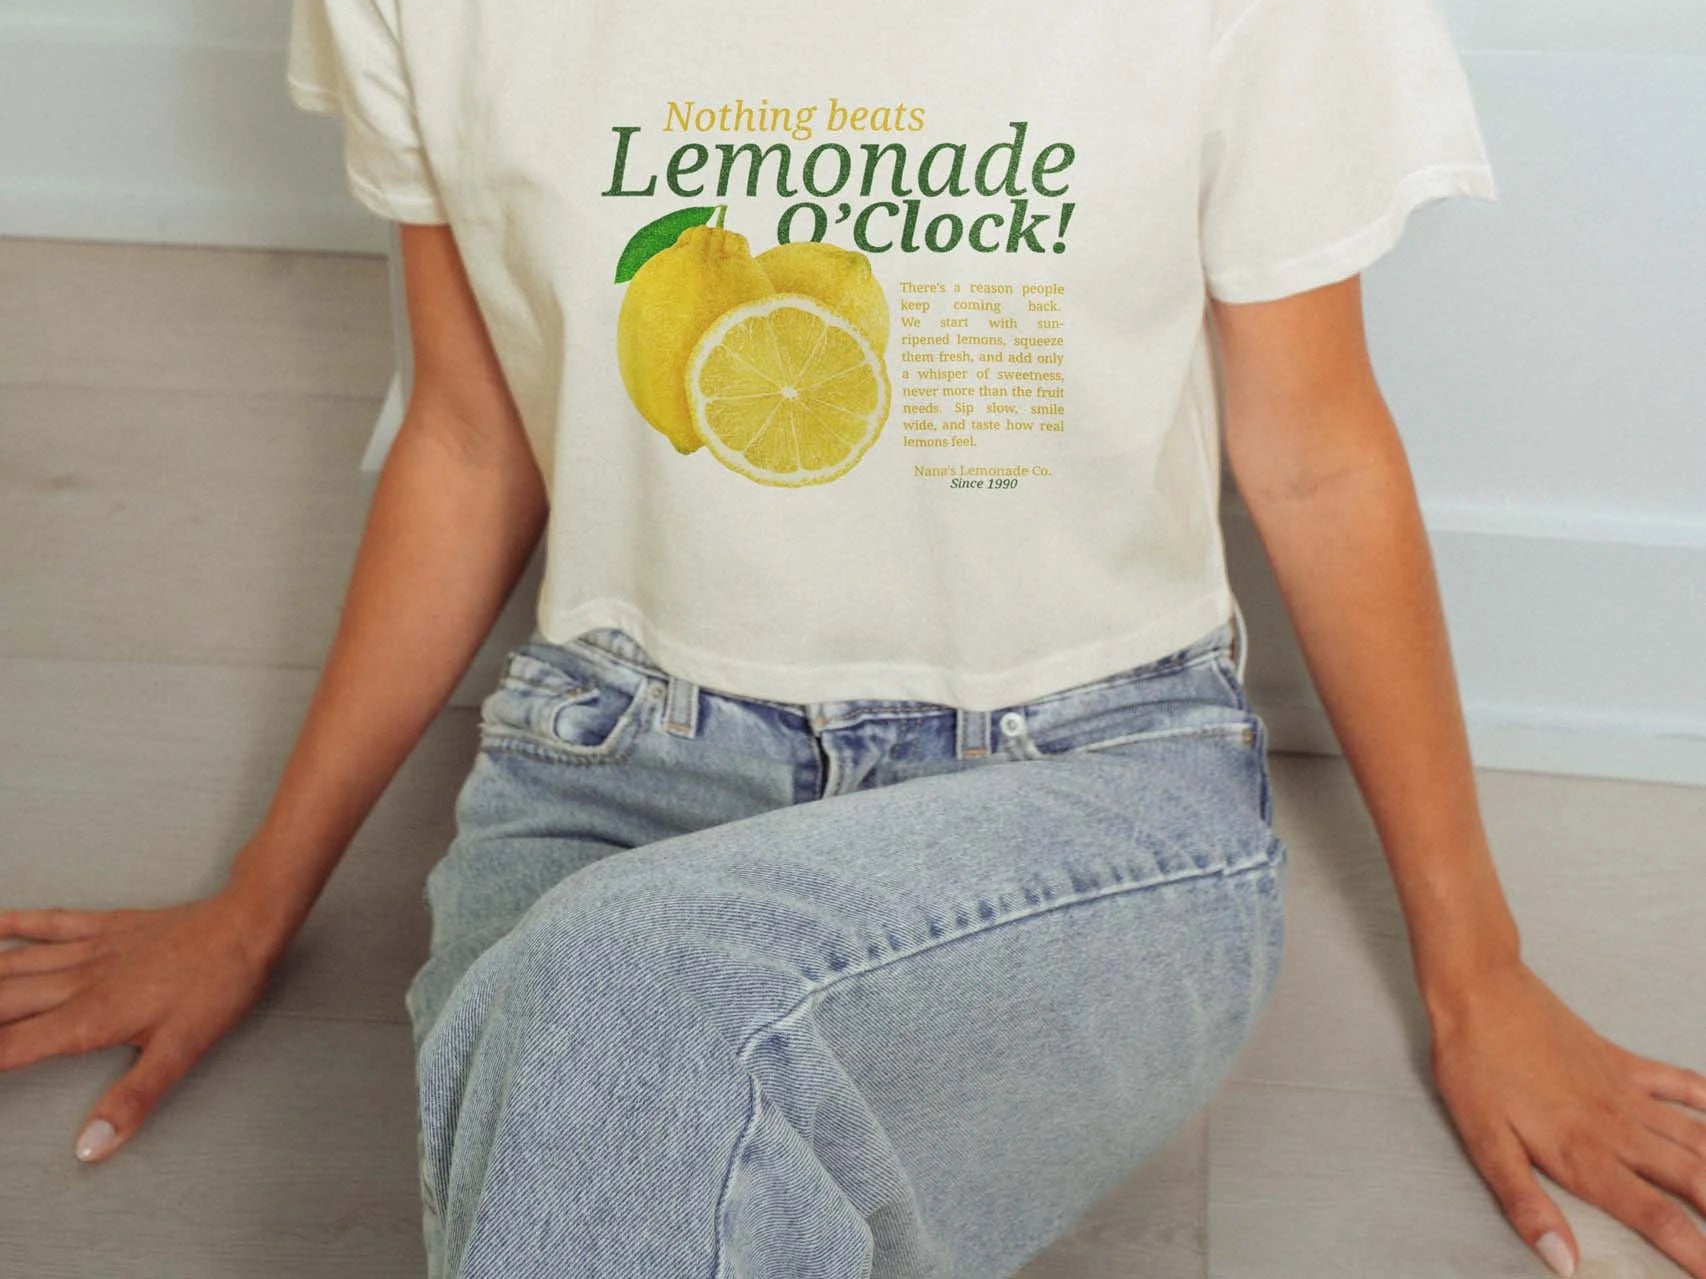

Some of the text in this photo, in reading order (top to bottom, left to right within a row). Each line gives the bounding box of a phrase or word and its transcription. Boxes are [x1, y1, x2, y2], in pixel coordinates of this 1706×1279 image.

[663, 98, 926, 141] Nothing beats
[601, 121, 1076, 198] Lemonade
[954, 284, 960, 294] a
[970, 284, 1013, 294] reason
[1022, 282, 1065, 297] people
[901, 299, 1061, 314] keep coming back.
[902, 317, 1064, 329] We start with sun-
[902, 334, 1064, 349] ripened lemons, squeeze
[902, 351, 1064, 366] them fresh, and add only
[902, 368, 1065, 382] a whisper of sweetness,
[903, 385, 1065, 398] never more than the fruit
[903, 402, 1065, 415] needs. Sip slow, smile
[903, 419, 1065, 432] wide, and taste how real
[903, 436, 977, 447] lemons feel.
[960, 465, 1029, 477] Lemonade
[1032, 465, 1052, 476] Co.
[950, 478, 1018, 489] Since 1990
